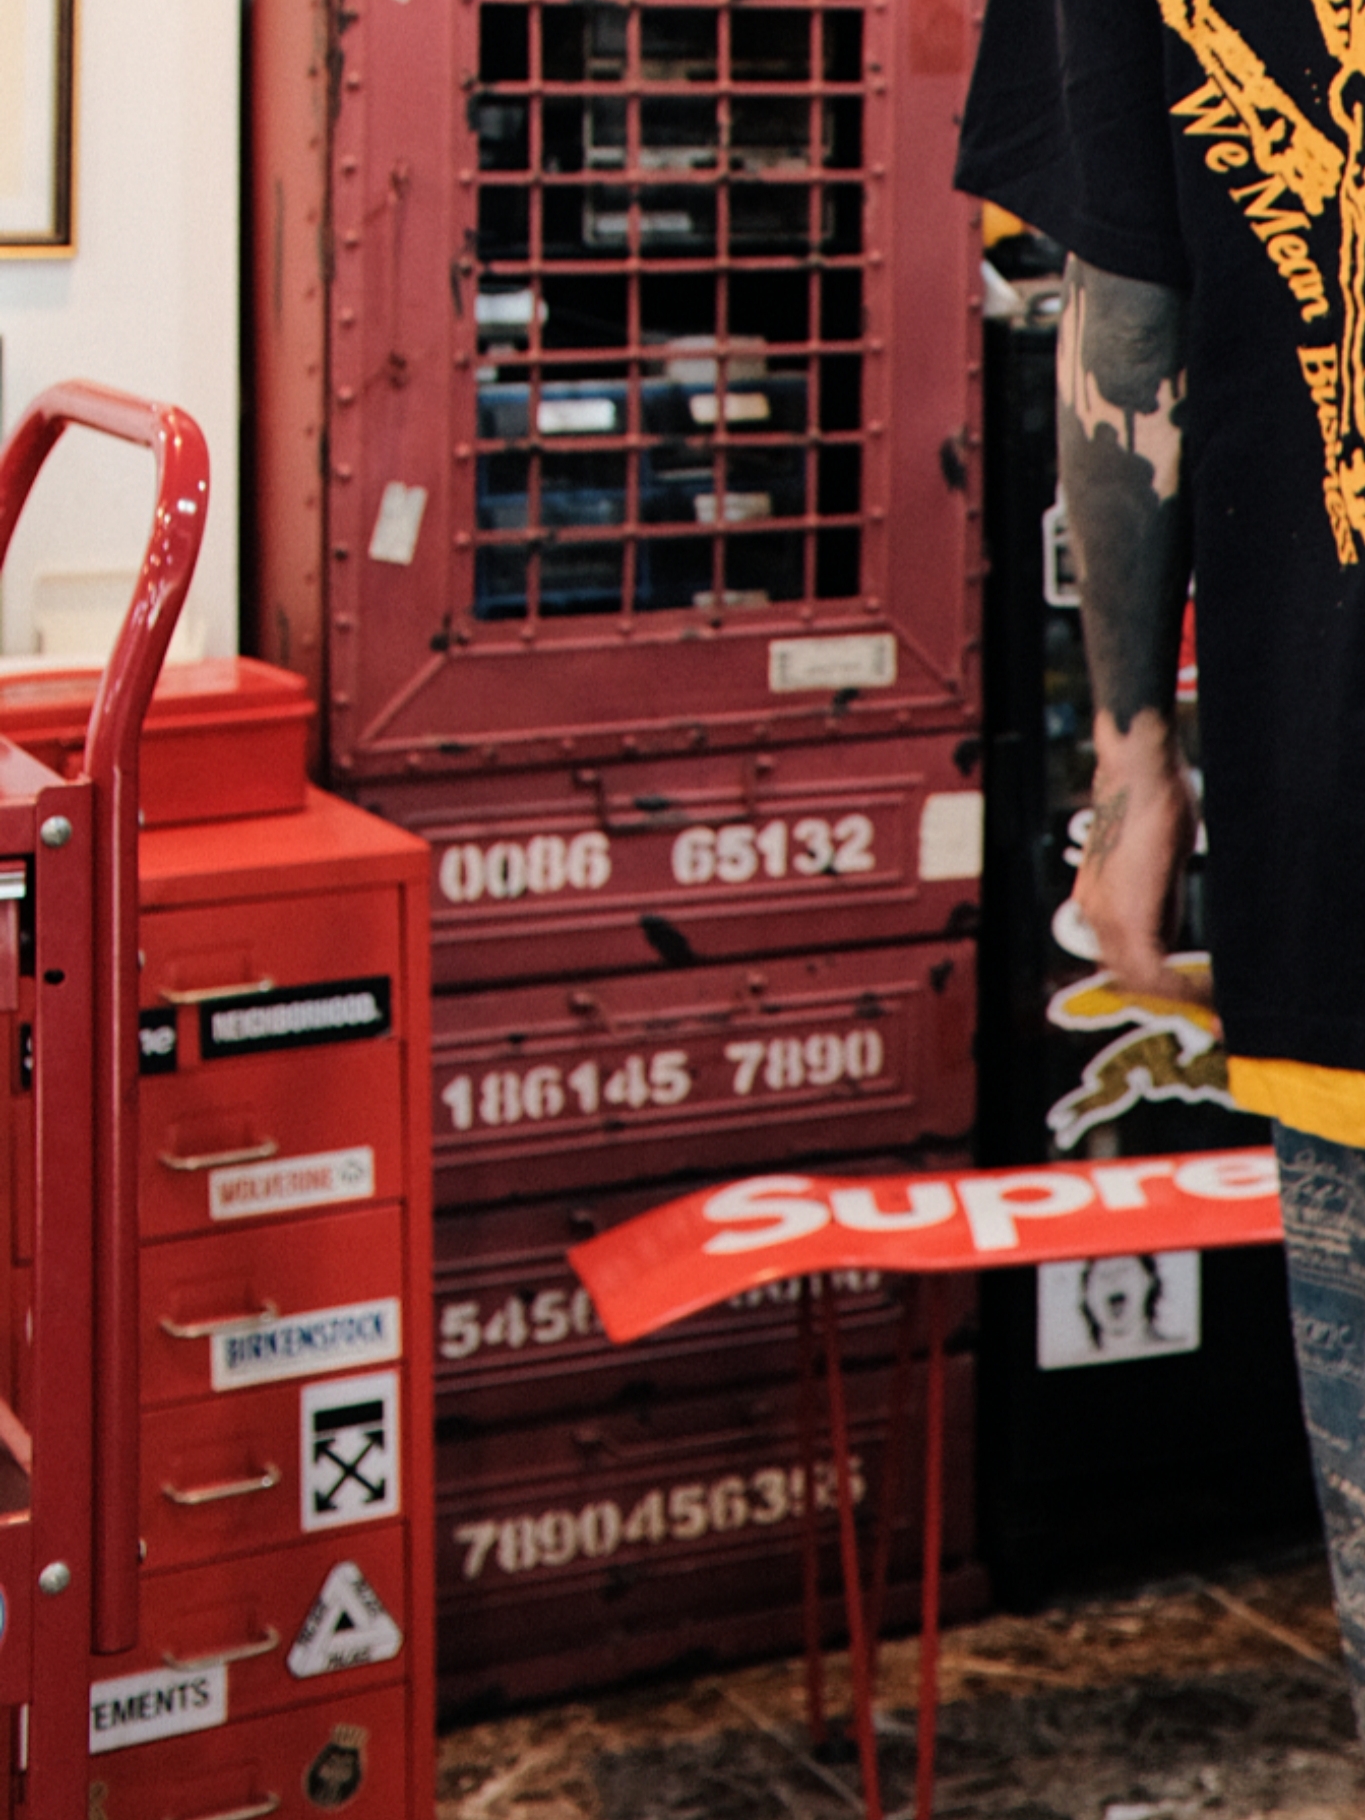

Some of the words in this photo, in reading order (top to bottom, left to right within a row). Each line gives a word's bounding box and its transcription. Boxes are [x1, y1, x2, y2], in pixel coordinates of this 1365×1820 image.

[1169, 78, 1252, 174] We
[1228, 175, 1330, 323] Mean
[440, 832, 611, 903] 0086
[672, 814, 877, 885] 65132
[443, 1051, 692, 1130] 186145
[726, 1029, 884, 1095] 7890
